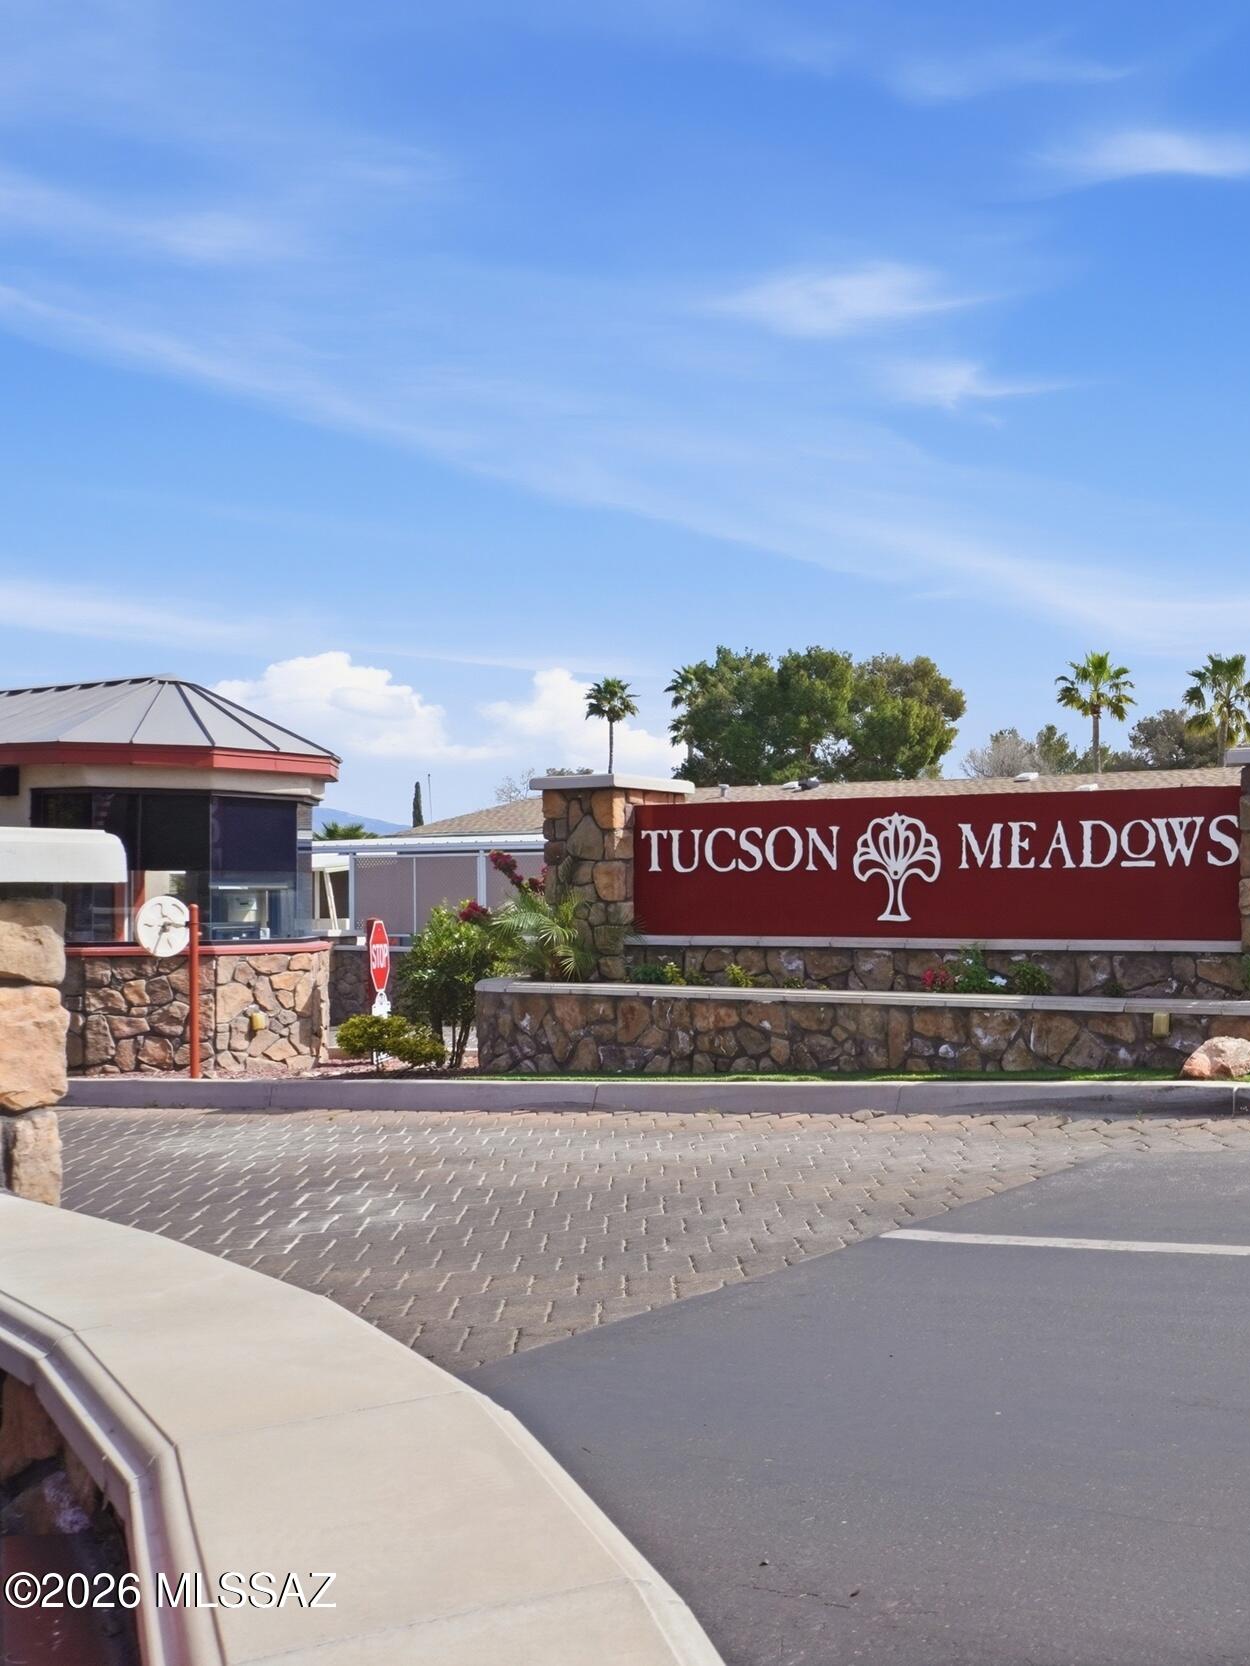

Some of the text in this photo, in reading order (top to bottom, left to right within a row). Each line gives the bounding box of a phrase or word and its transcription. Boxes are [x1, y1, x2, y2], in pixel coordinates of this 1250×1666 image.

[641, 815, 1240, 873] TUCSON MEADOWS
[372, 944, 387, 969] STOP
